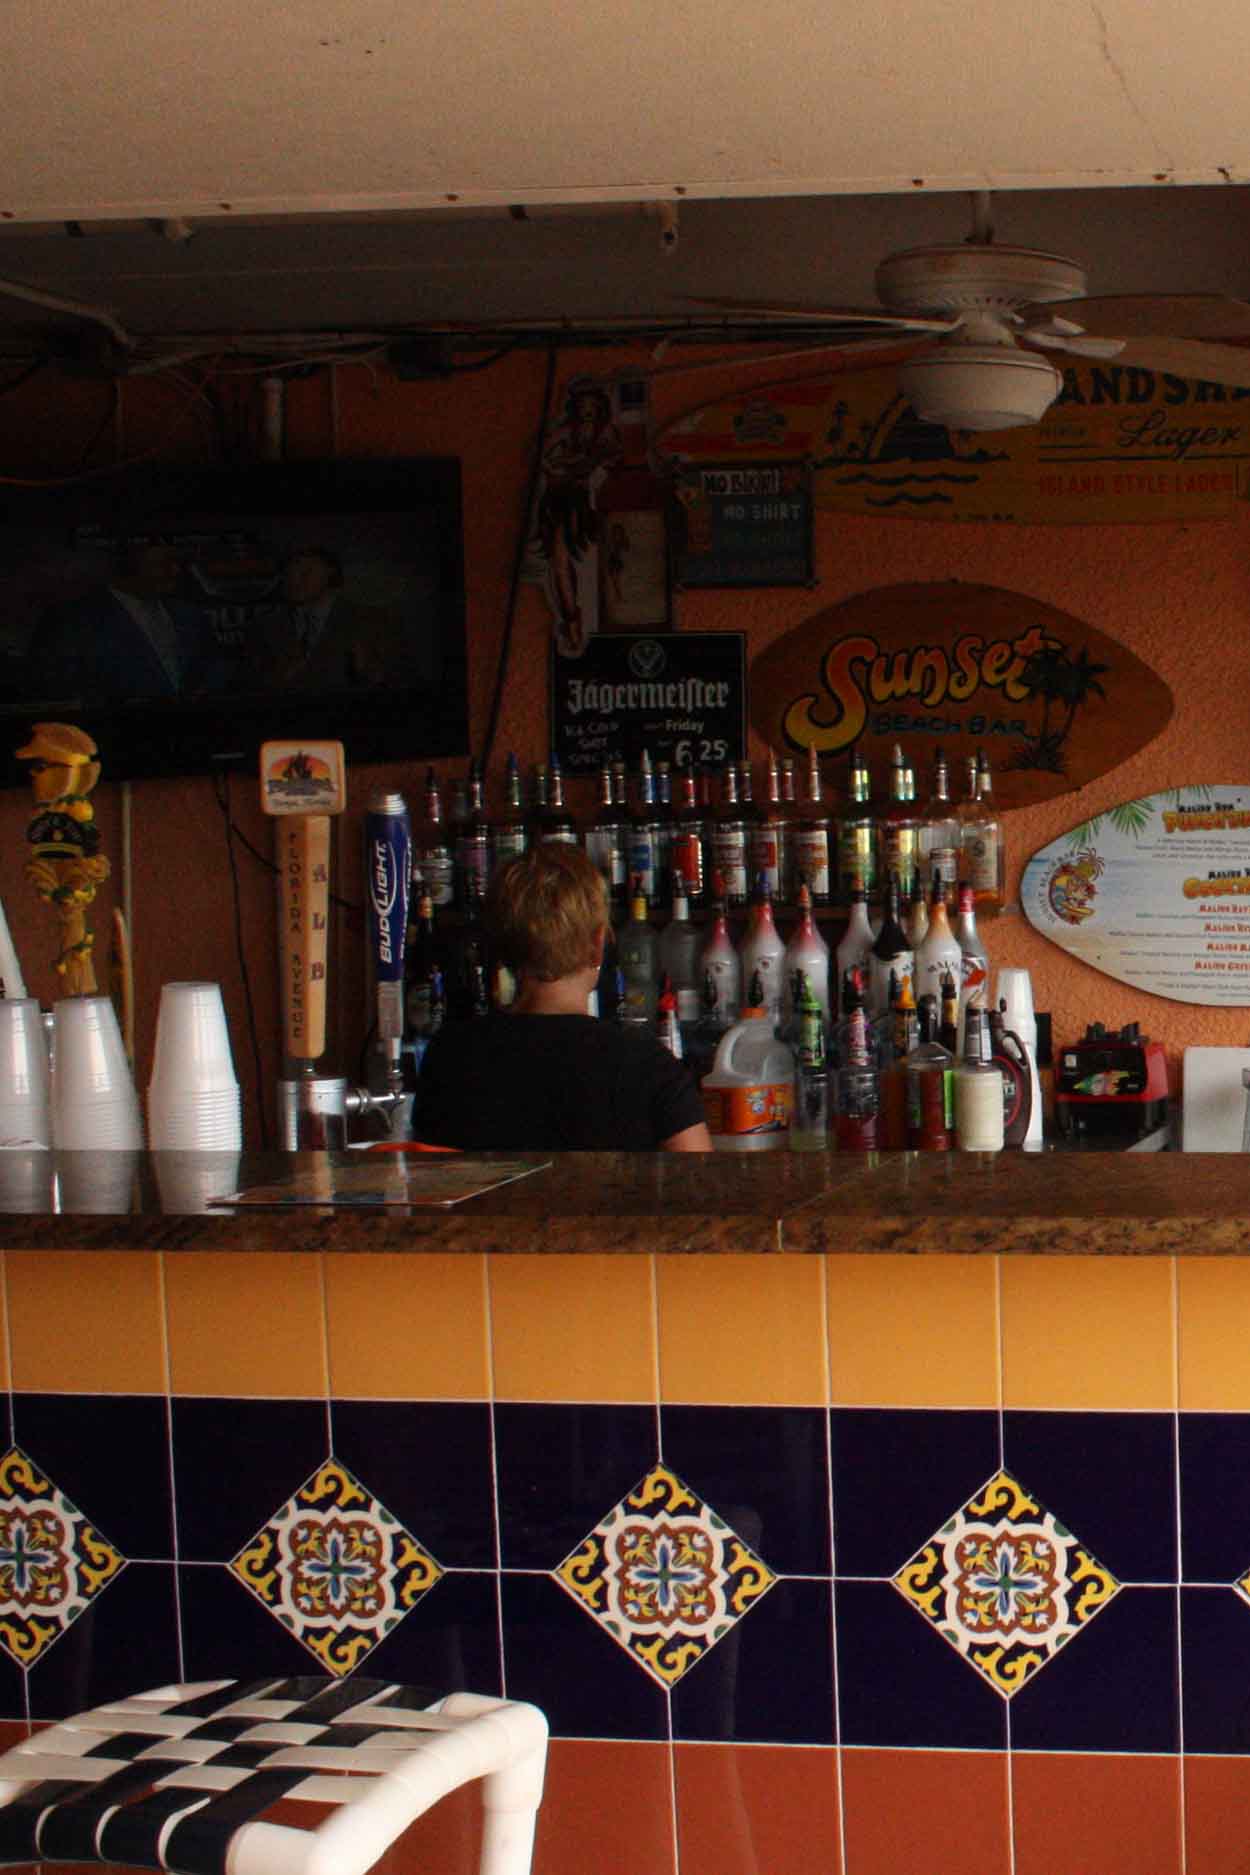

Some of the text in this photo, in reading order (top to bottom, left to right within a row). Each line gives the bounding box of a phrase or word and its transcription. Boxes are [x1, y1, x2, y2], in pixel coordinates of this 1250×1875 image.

[1116, 410, 1240, 462] Lager
[752, 503, 800, 520] SHIRT
[782, 624, 1063, 756] Sunset
[665, 719, 705, 734] Friday
[870, 713, 1027, 737] BEACH BAR
[375, 839, 393, 965] BUD LIGHT
